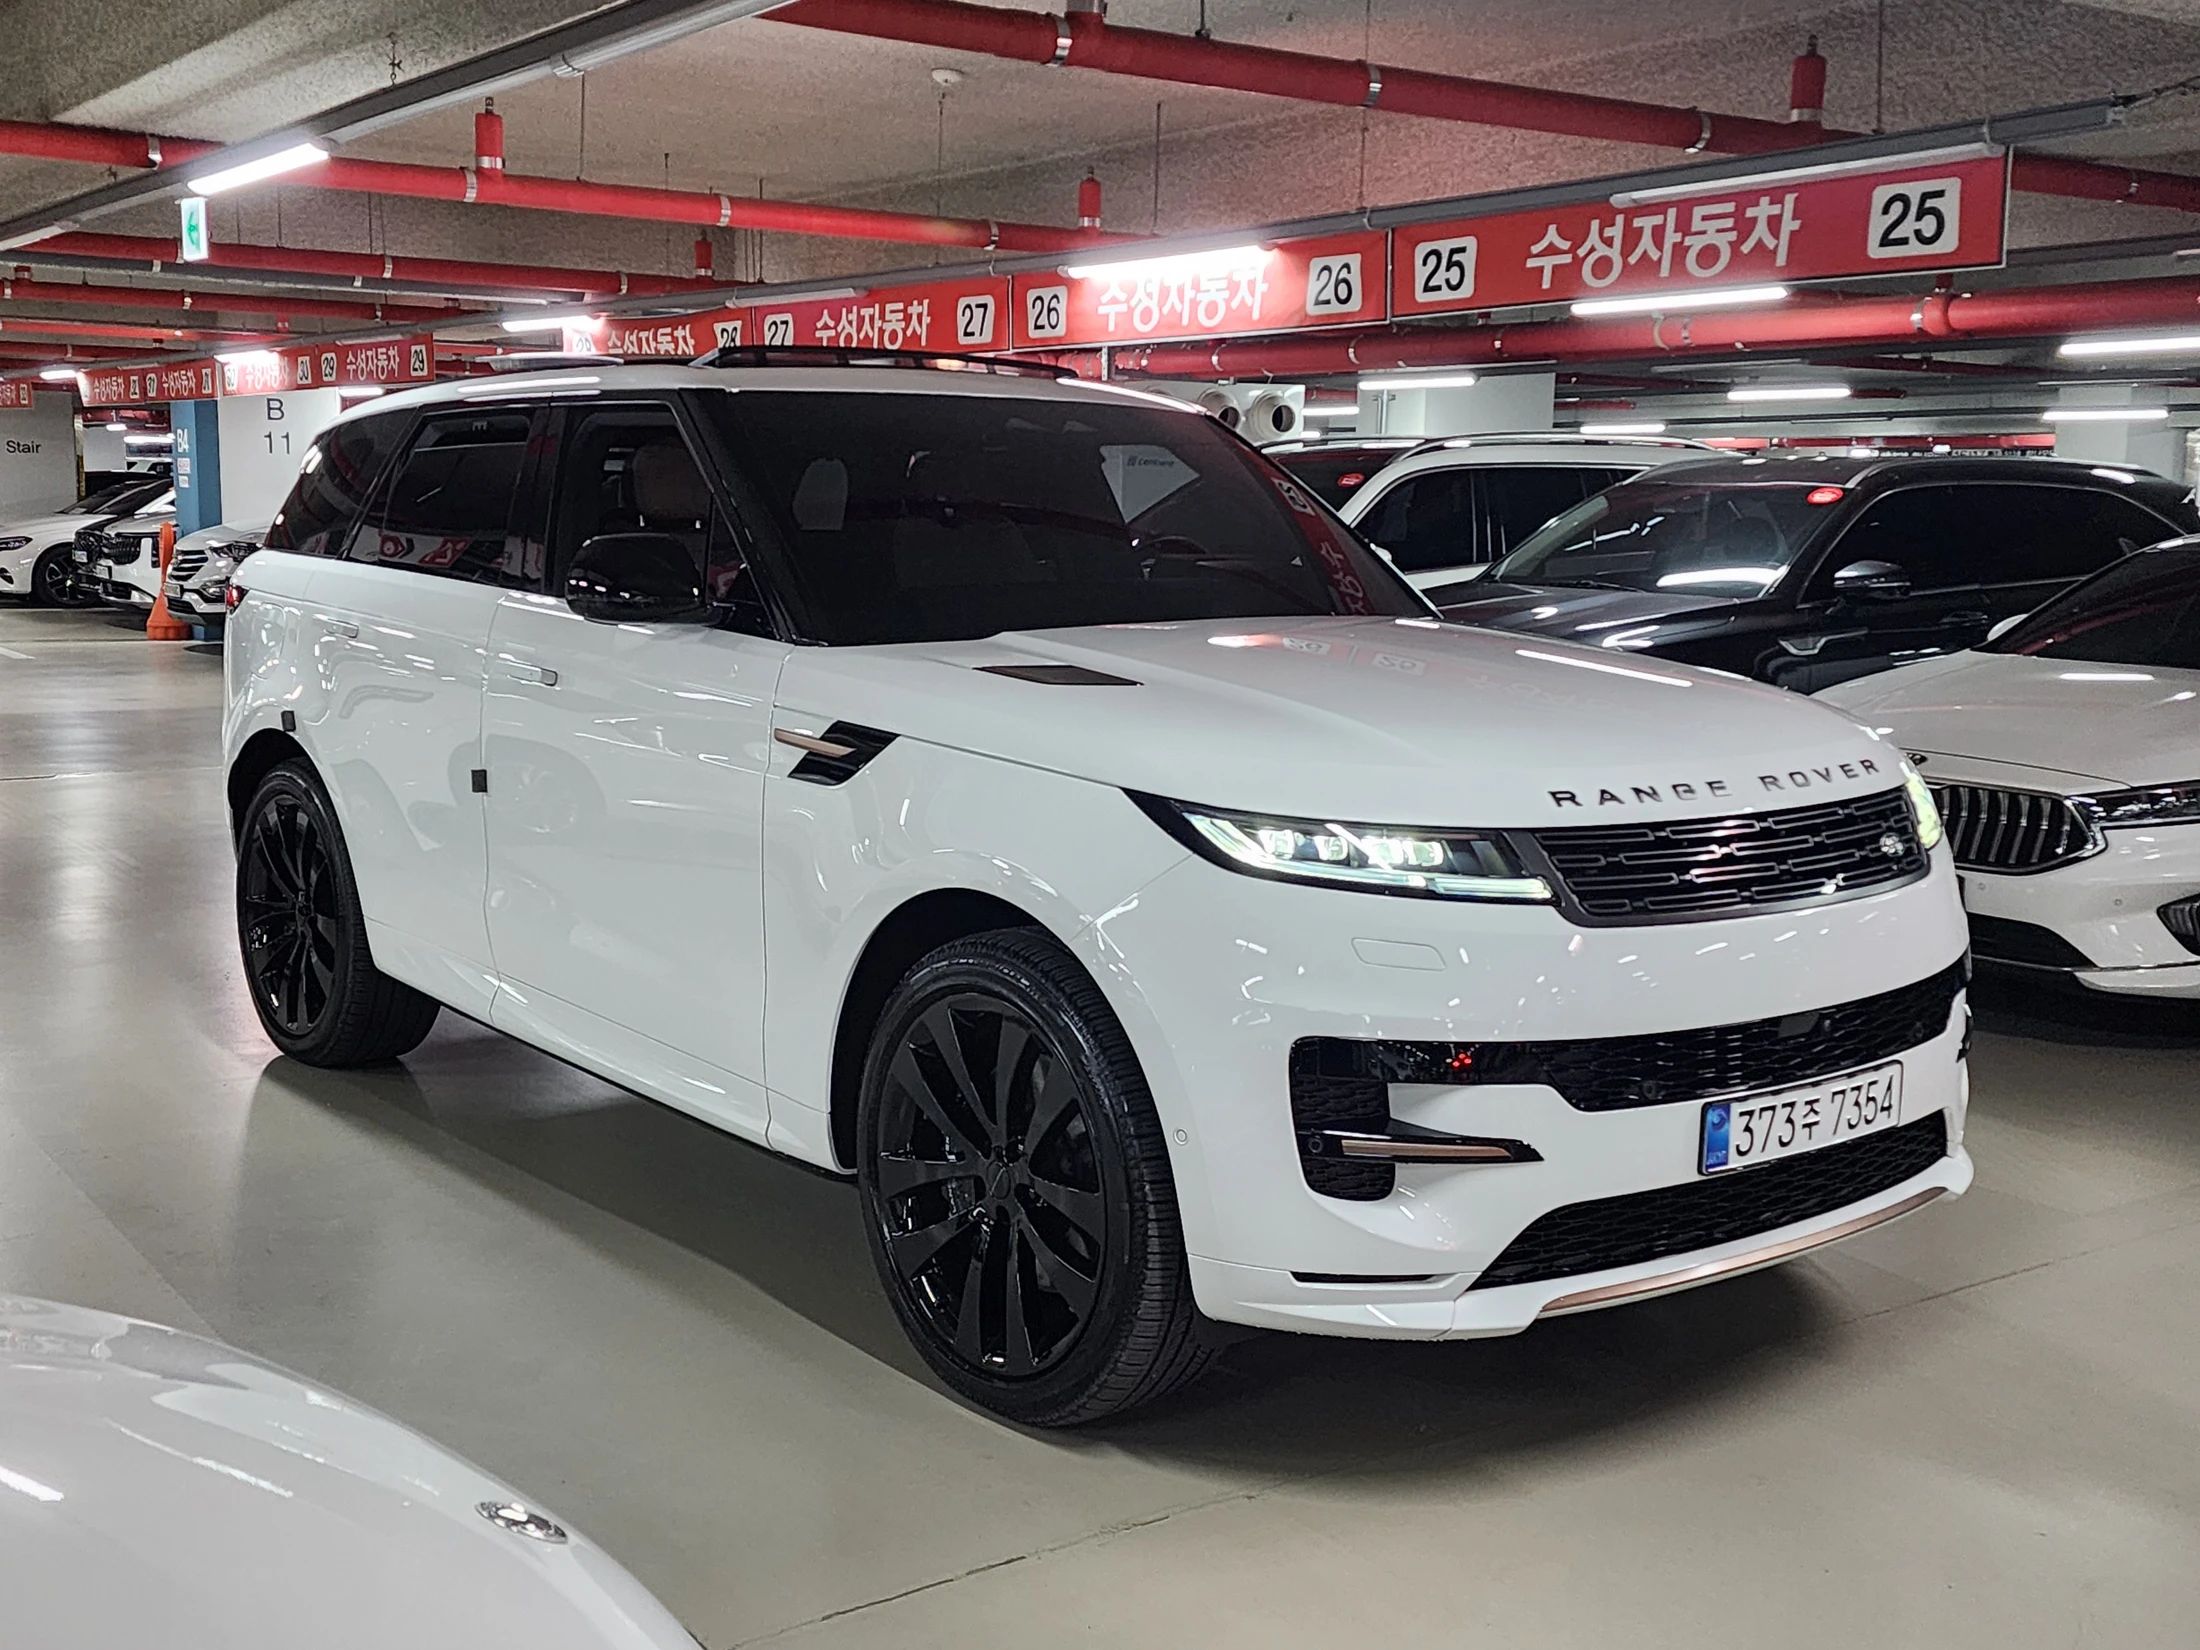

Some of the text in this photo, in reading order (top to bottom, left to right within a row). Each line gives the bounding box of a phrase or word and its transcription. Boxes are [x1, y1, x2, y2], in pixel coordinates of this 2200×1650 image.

[1420, 189, 1947, 294] 25 수성자동차 25
[1031, 293, 1061, 331] 26
[1313, 262, 1353, 307] 26
[767, 299, 989, 350] 27 수성자동차 27
[322, 344, 425, 380] 29 수성자동차 29
[266, 397, 285, 420] B
[6, 440, 42, 454] Stair
[176, 428, 190, 453] B4
[263, 431, 292, 455] 11
[1548, 758, 1882, 808] RANGE ROVER
[1734, 1073, 1895, 1158] 373주 7354
